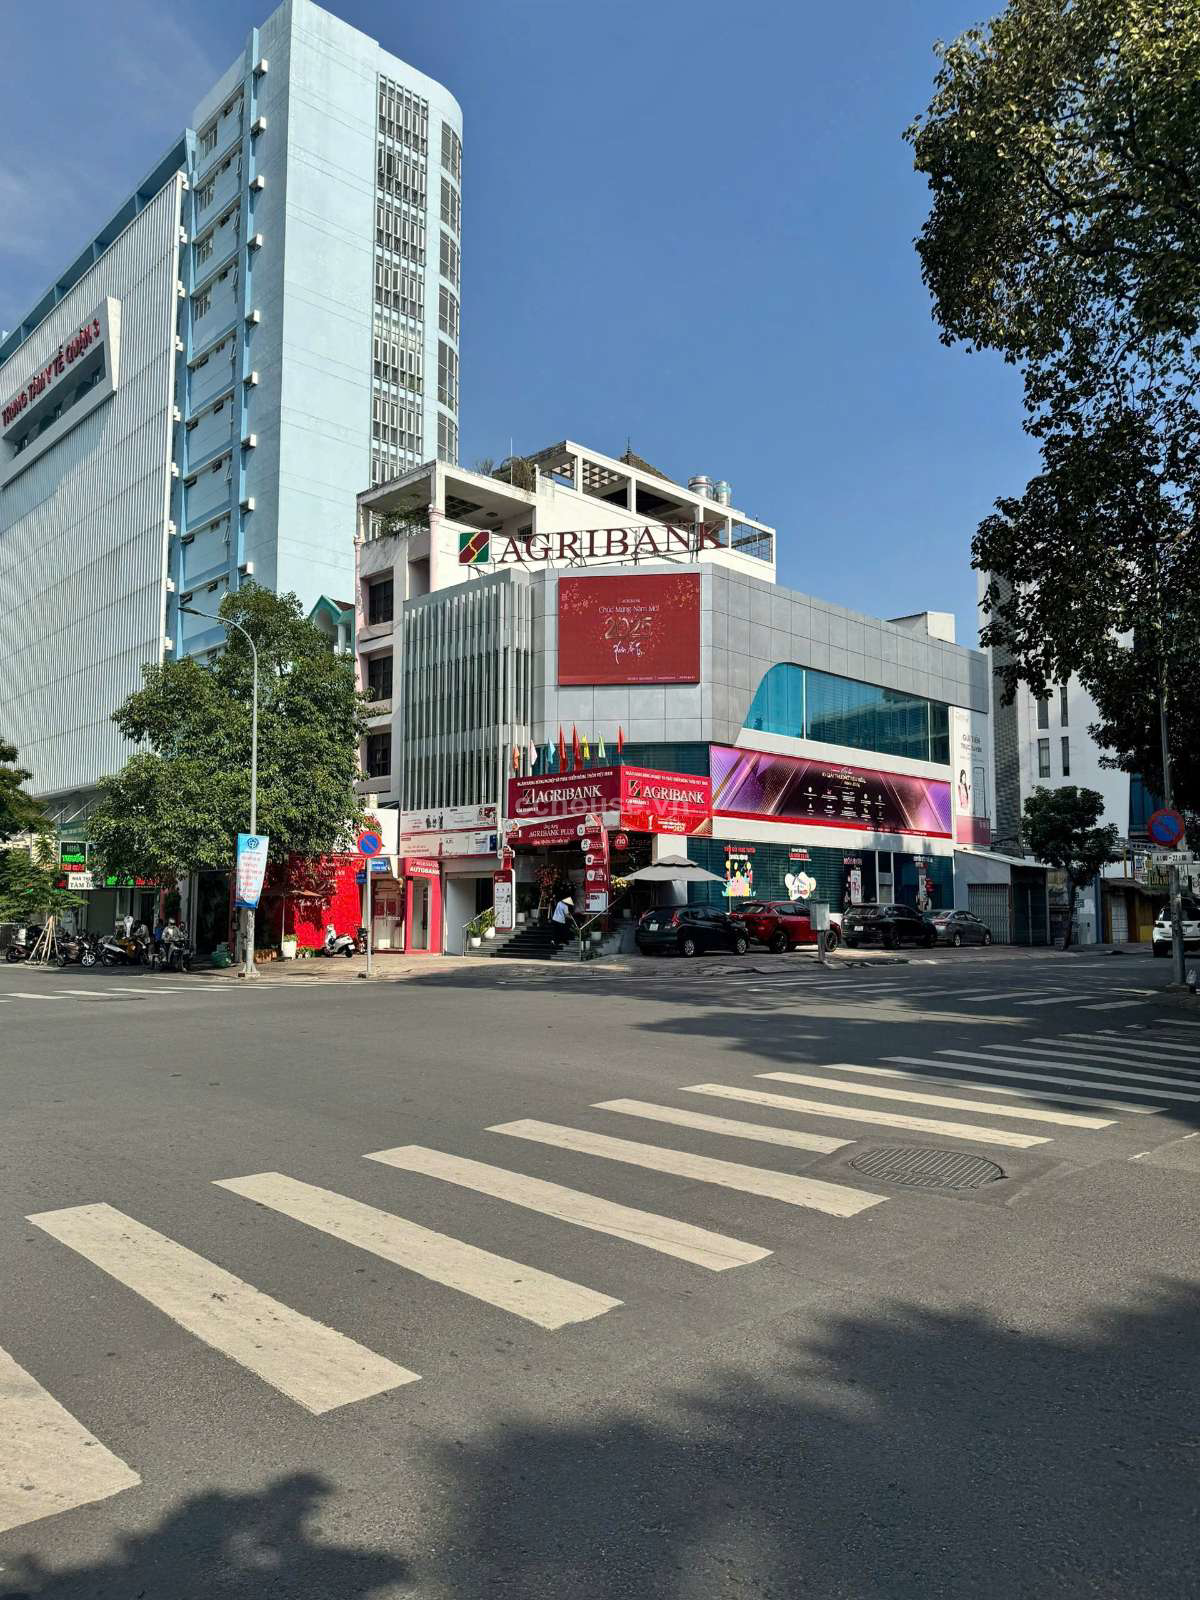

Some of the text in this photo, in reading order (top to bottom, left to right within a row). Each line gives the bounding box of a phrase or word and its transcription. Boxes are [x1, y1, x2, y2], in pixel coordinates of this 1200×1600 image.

[1, 318, 100, 427] TRUNG TÂM Y TẾ QUẬN 3
[499, 522, 728, 562] AGRIBANK
[604, 616, 652, 640] 2025
[536, 784, 604, 803] AGRIBANK
[643, 786, 704, 804] AGRIBANK
